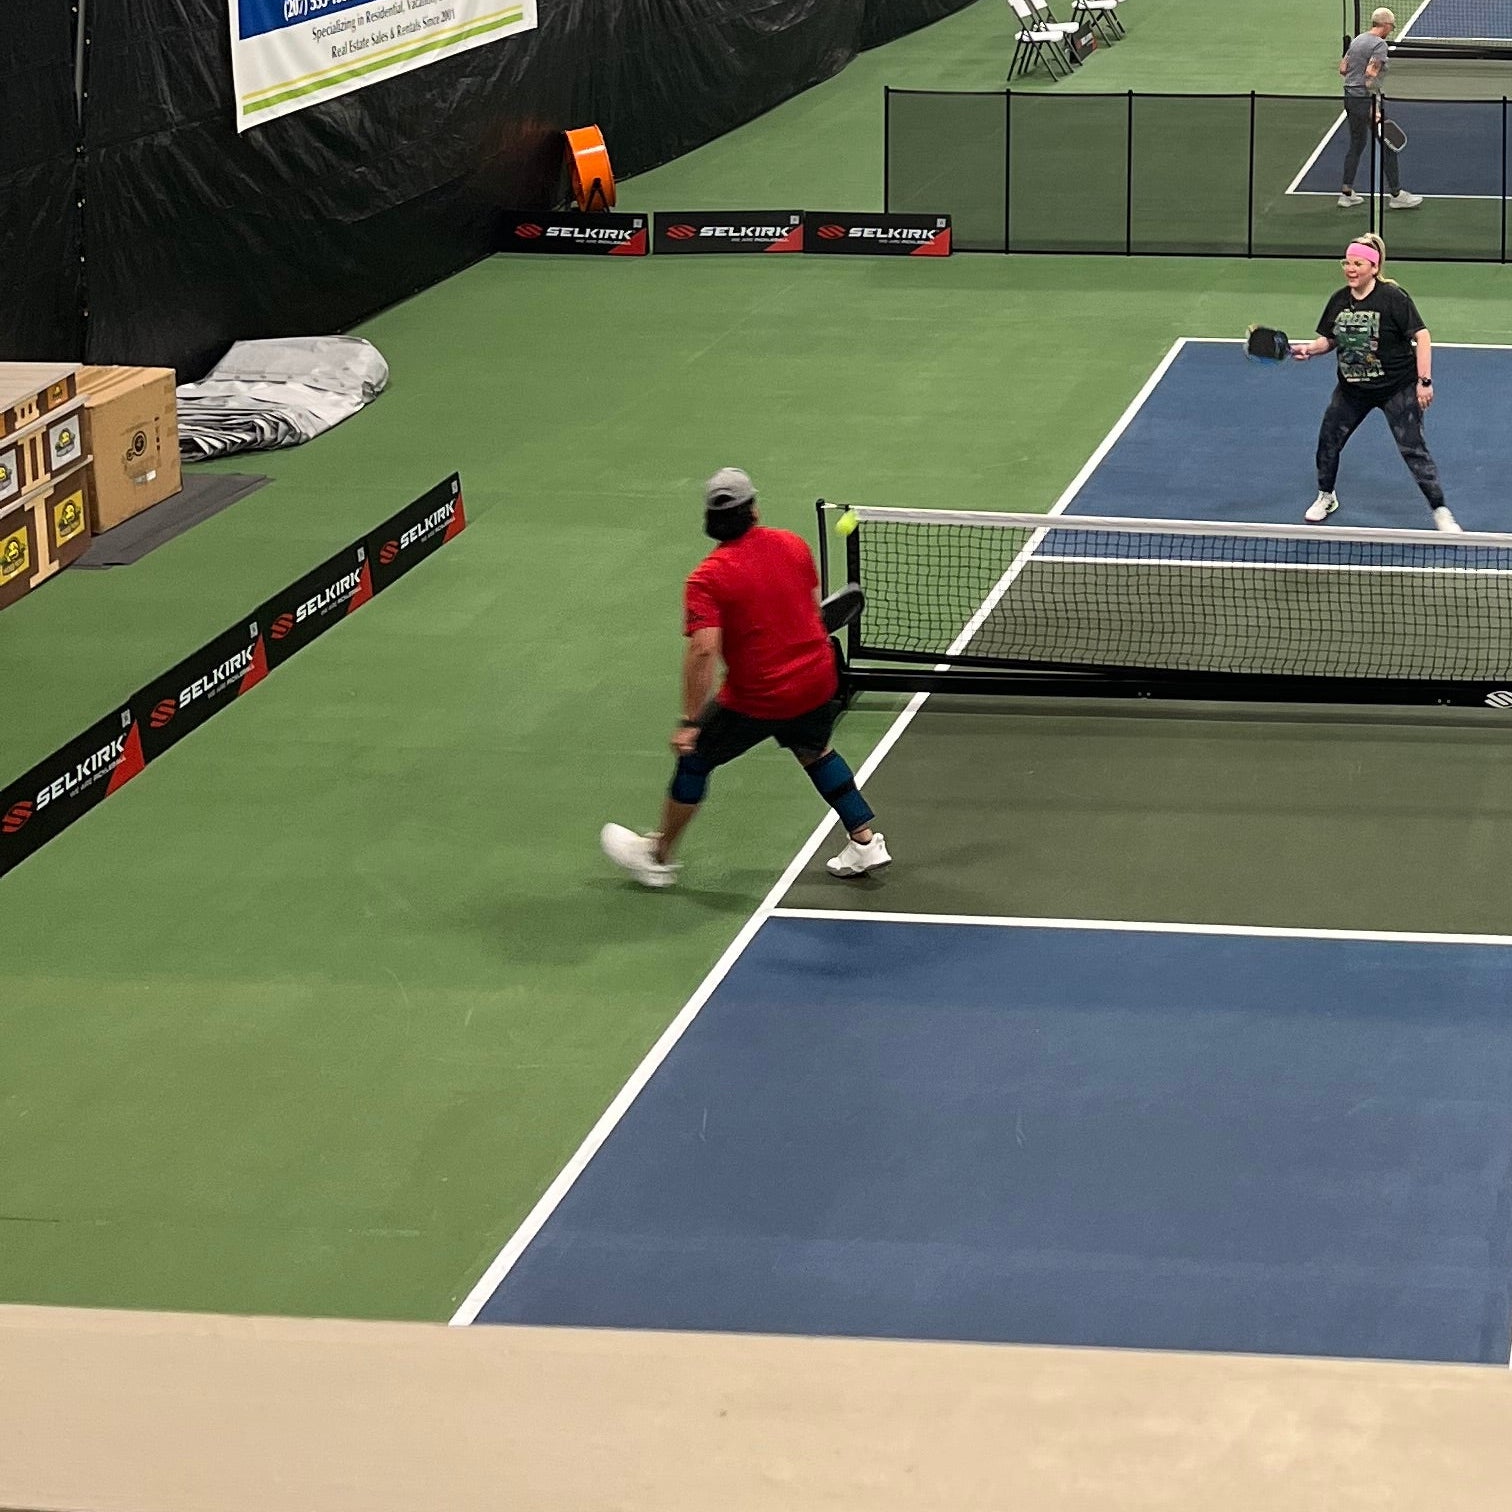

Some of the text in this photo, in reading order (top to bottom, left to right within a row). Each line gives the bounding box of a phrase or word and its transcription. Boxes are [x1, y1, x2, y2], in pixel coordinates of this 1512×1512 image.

[312, 18, 357, 43] Specializing
[358, 16, 365, 26] in
[331, 42, 348, 59] Real
[350, 36, 370, 53] Estate
[372, 30, 389, 45] Sales
[397, 21, 422, 38] Rentals
[423, 14, 440, 29] Since
[545, 227, 633, 239] SELKIRK
[699, 226, 791, 237] SELKIRK
[848, 227, 936, 239] SELKIRK
[400, 499, 455, 550] SELKIRK
[295, 567, 361, 623] SELKIRK
[179, 644, 253, 709] SELKIRK
[36, 734, 125, 811] SELKIRK
